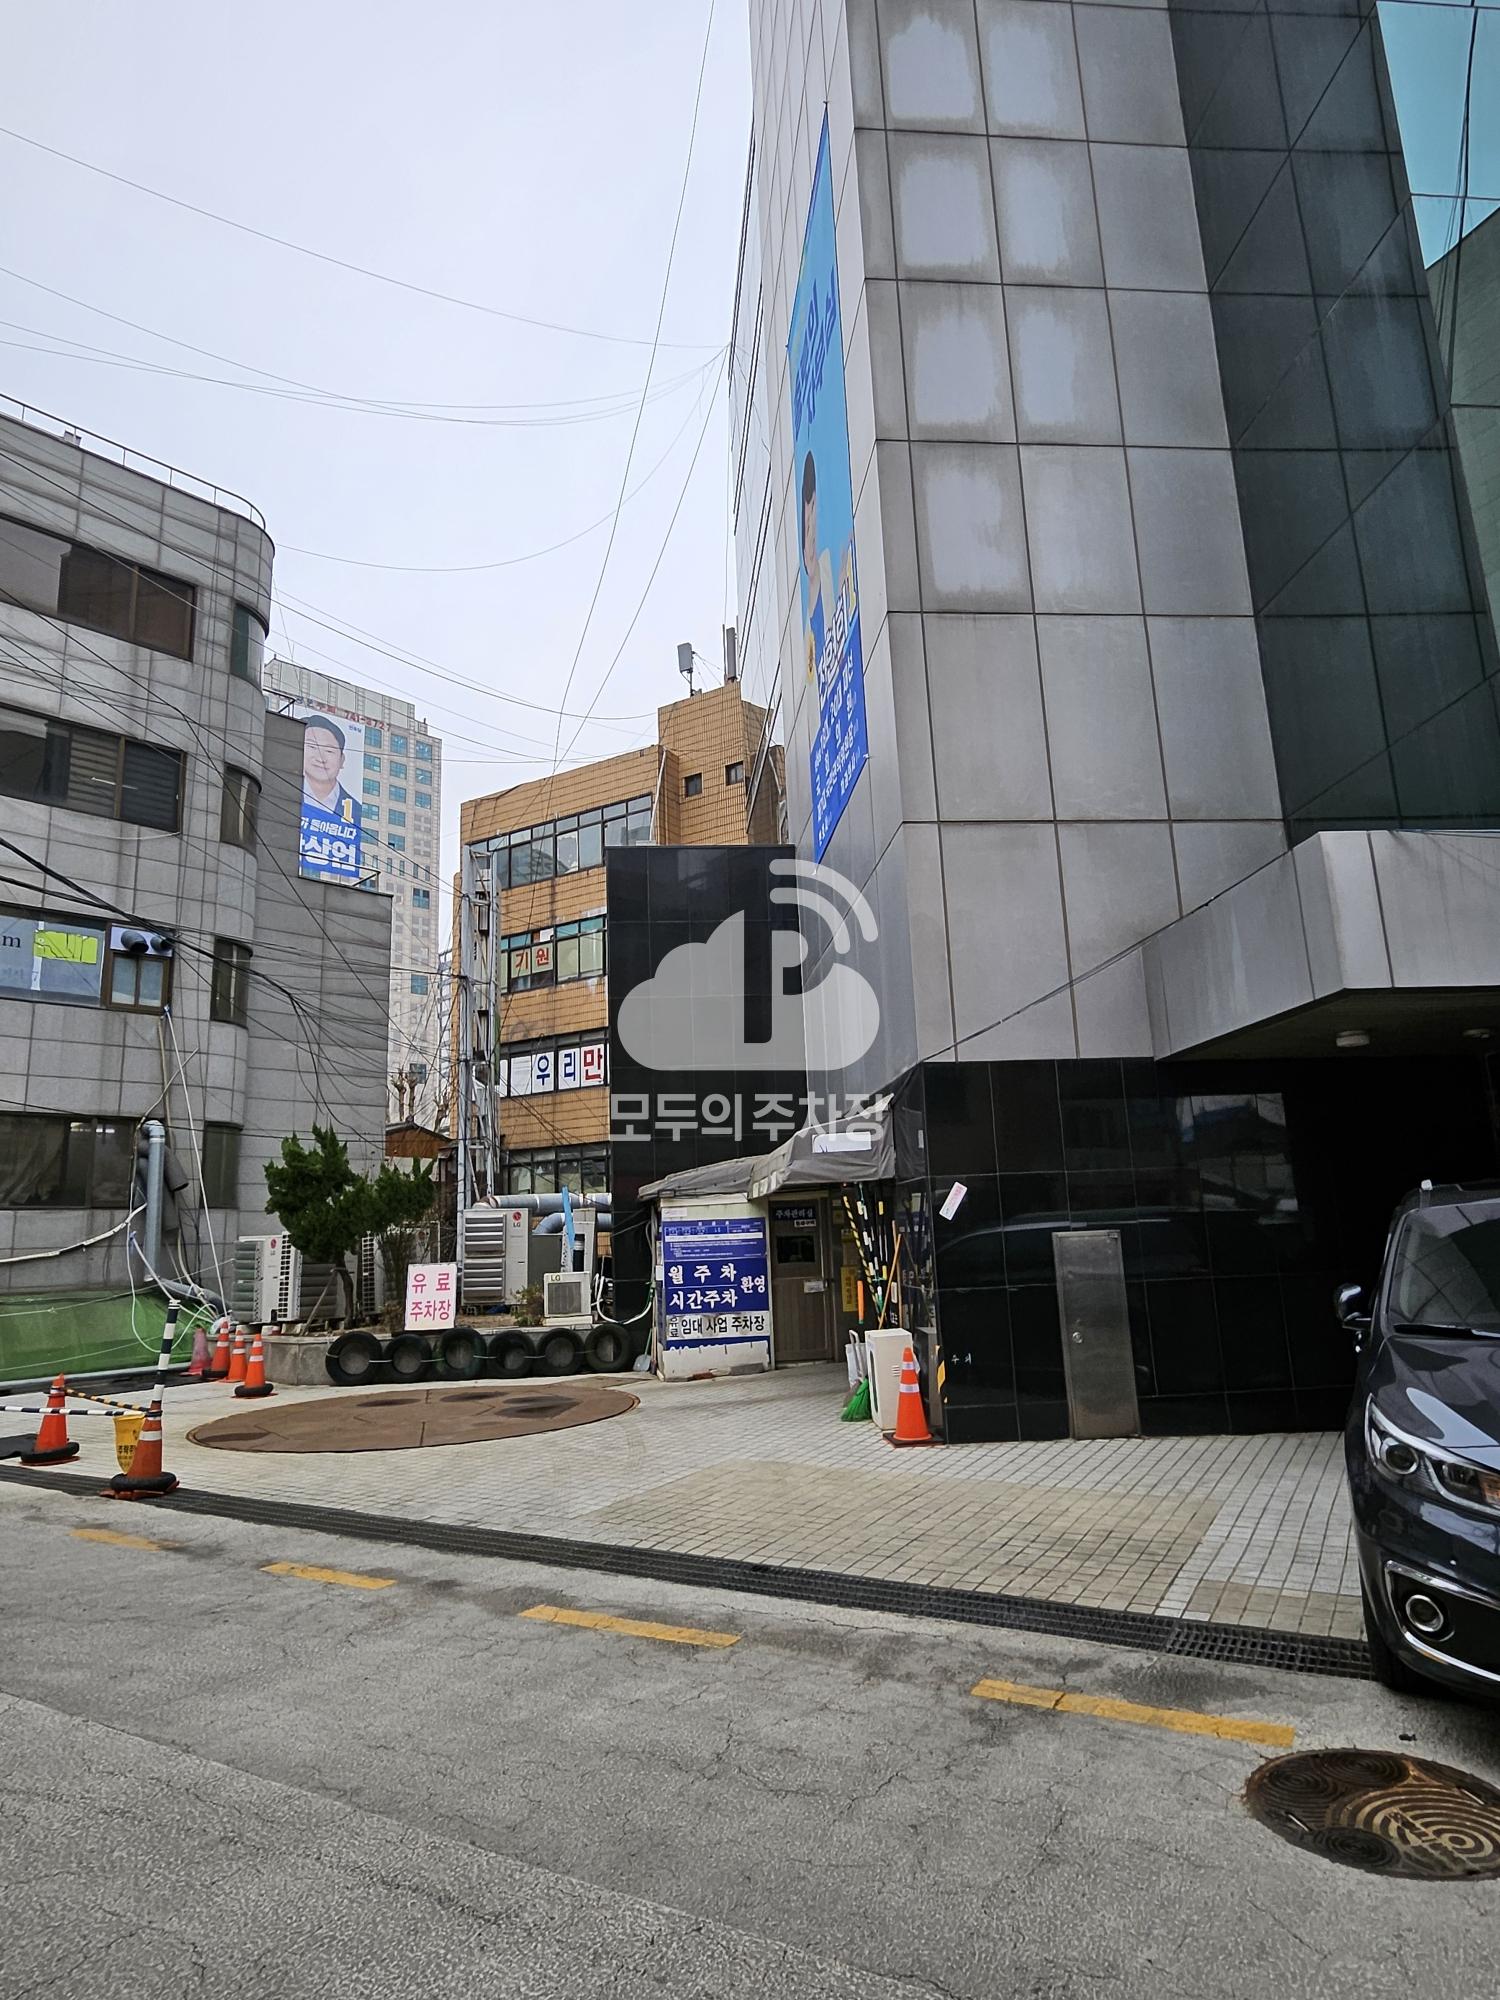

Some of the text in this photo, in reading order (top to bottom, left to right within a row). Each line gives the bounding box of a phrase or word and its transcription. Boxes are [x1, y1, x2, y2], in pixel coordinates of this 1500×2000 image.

[817, 579, 849, 711] 전현희
[341, 798, 354, 823] 1
[310, 819, 357, 840] 돌아옵니다
[301, 834, 356, 872] 상언
[515, 948, 549, 970] 기원
[740, 1275, 766, 1293] 환영
[669, 1288, 738, 1310] 시간주차
[410, 1300, 451, 1322] 주차장
[669, 1316, 679, 1338] 유료
[681, 1316, 765, 1334] 임대 사업 주차장
